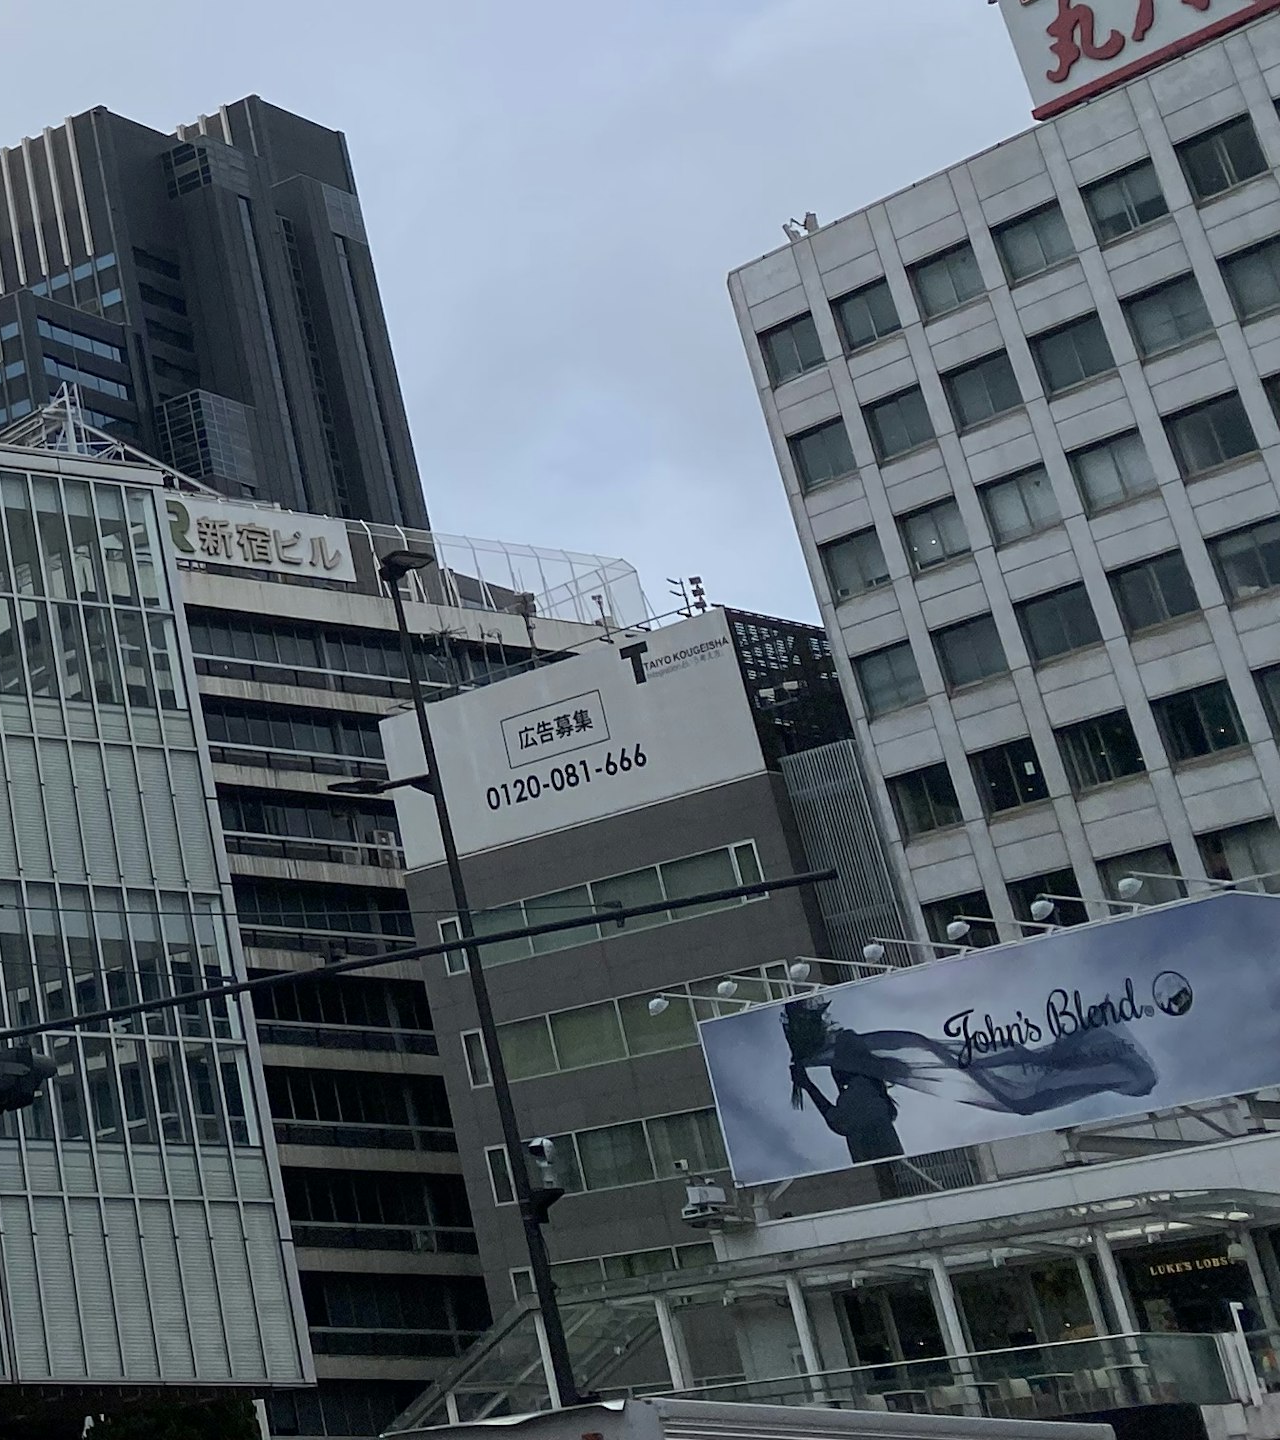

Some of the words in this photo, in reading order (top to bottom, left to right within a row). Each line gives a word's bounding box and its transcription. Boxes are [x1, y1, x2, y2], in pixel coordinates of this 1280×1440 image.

[643, 655, 672, 671] TAIYO
[673, 636, 730, 662] KOUGEISHA
[518, 709, 594, 750] 広告募集
[486, 743, 647, 810] 0120-081-666
[943, 1009, 1042, 1069] John's
[1149, 1261, 1193, 1276] LUKE'S
